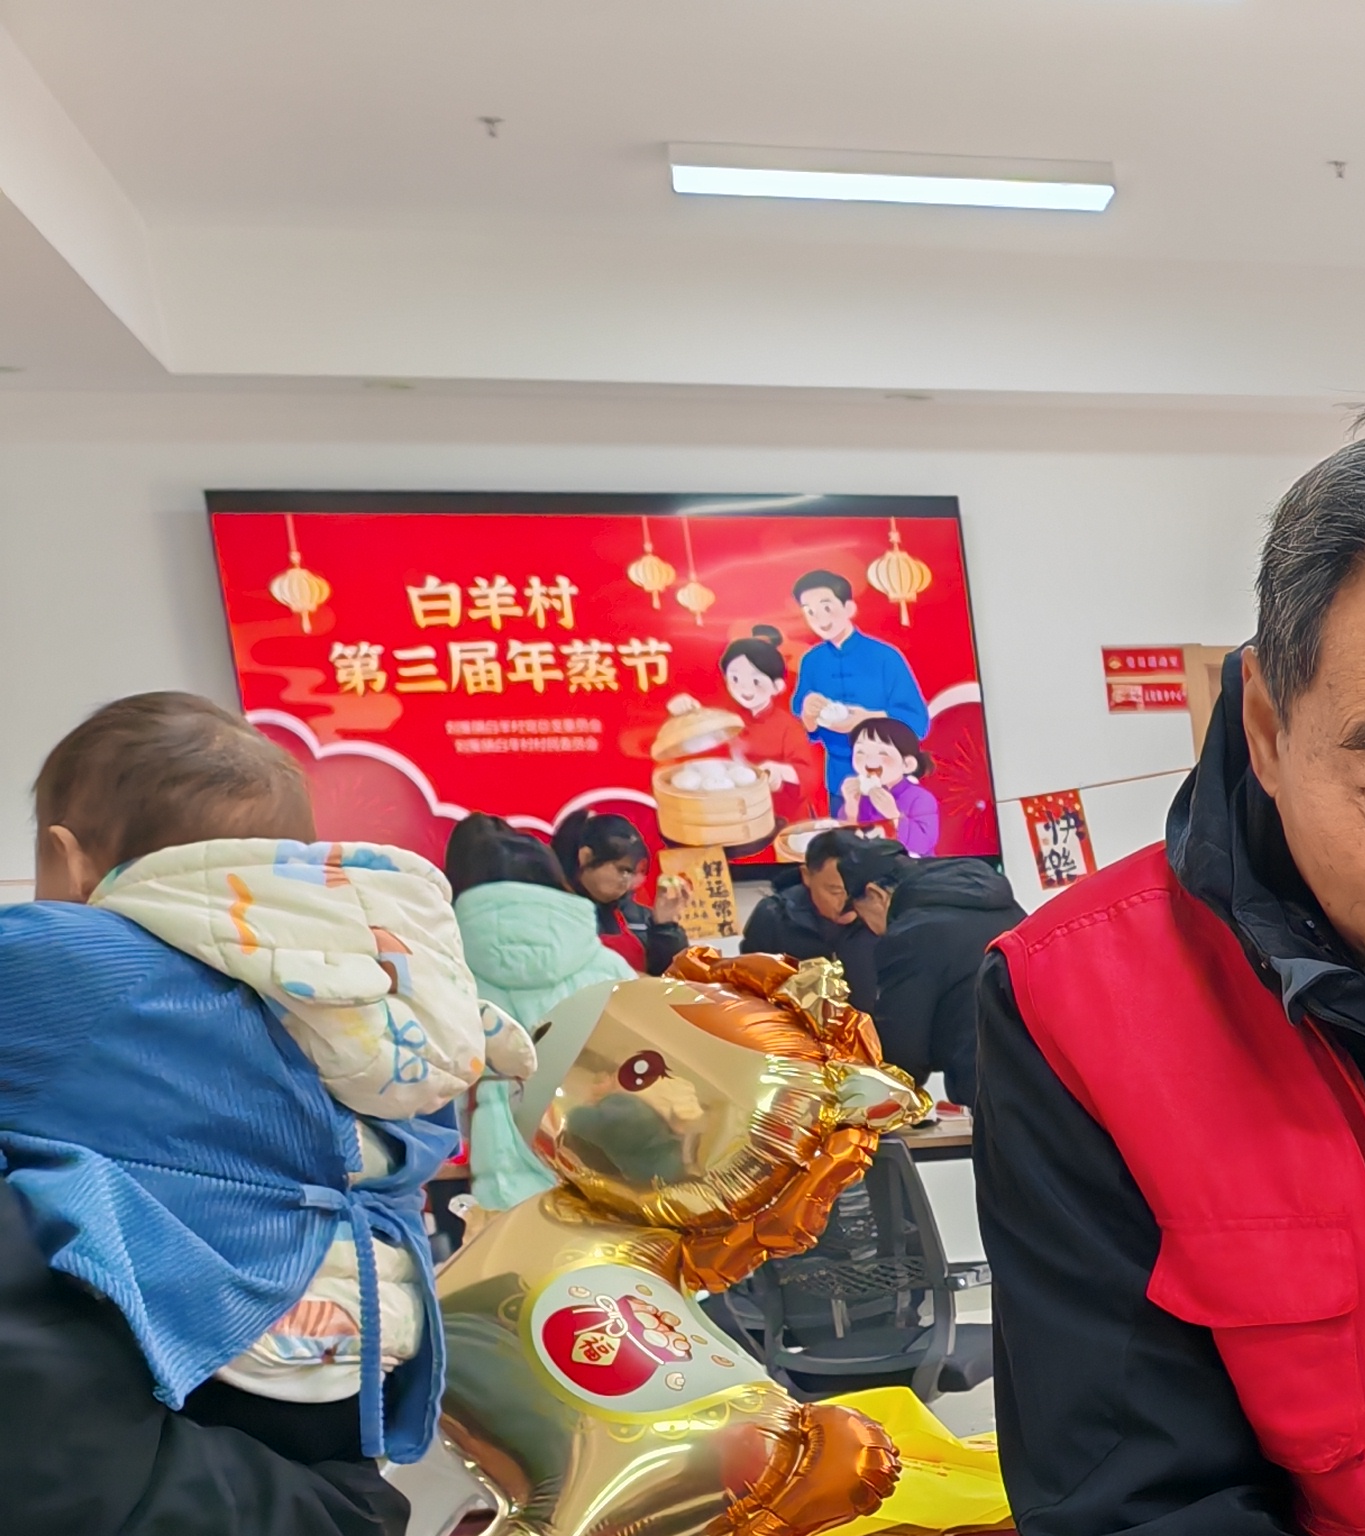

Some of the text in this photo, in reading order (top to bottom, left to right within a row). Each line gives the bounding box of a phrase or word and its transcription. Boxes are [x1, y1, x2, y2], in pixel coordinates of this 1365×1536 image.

[406, 575, 580, 630] 白羊村
[328, 638, 672, 696] 第三届年蒸节
[578, 1336, 616, 1362] 福
